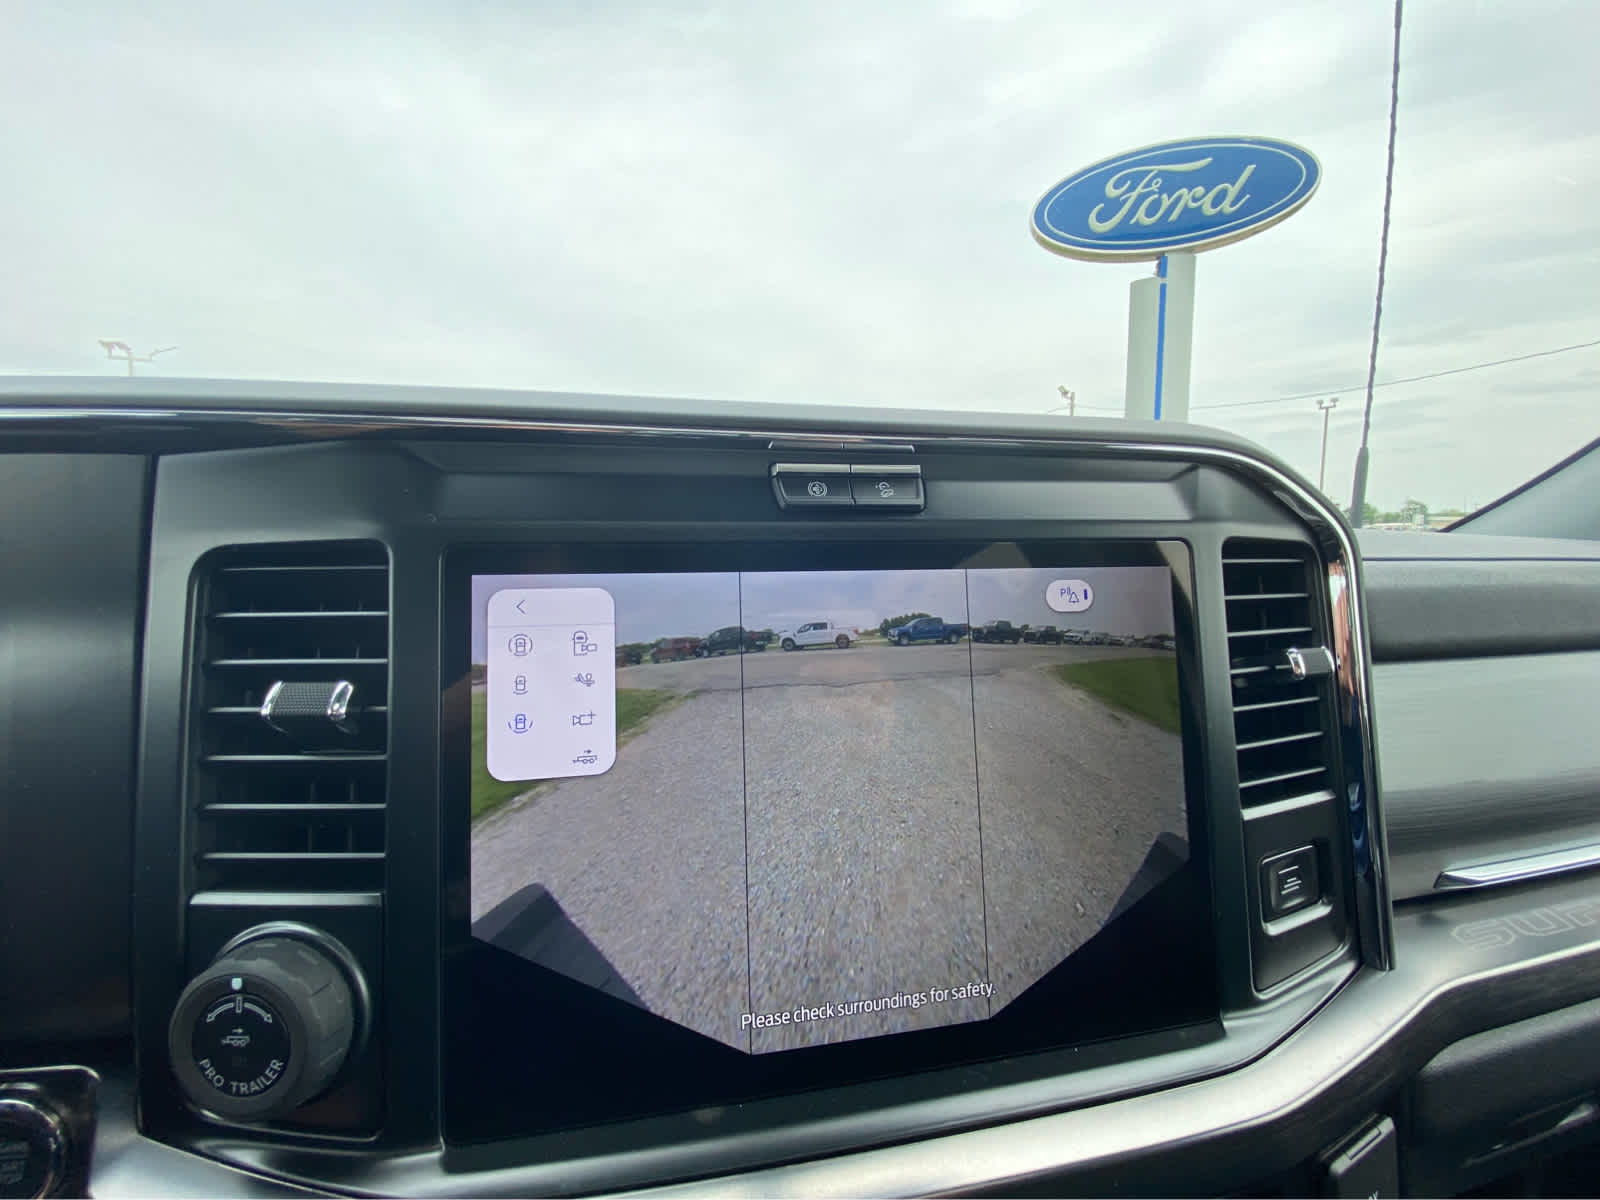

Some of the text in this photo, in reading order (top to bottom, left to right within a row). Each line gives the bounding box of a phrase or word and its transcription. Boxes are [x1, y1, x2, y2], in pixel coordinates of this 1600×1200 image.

[1088, 157, 1256, 233] Ford
[741, 980, 997, 1030] Please check surroundings for safety.
[200, 1058, 284, 1095] PRO TRAILER
